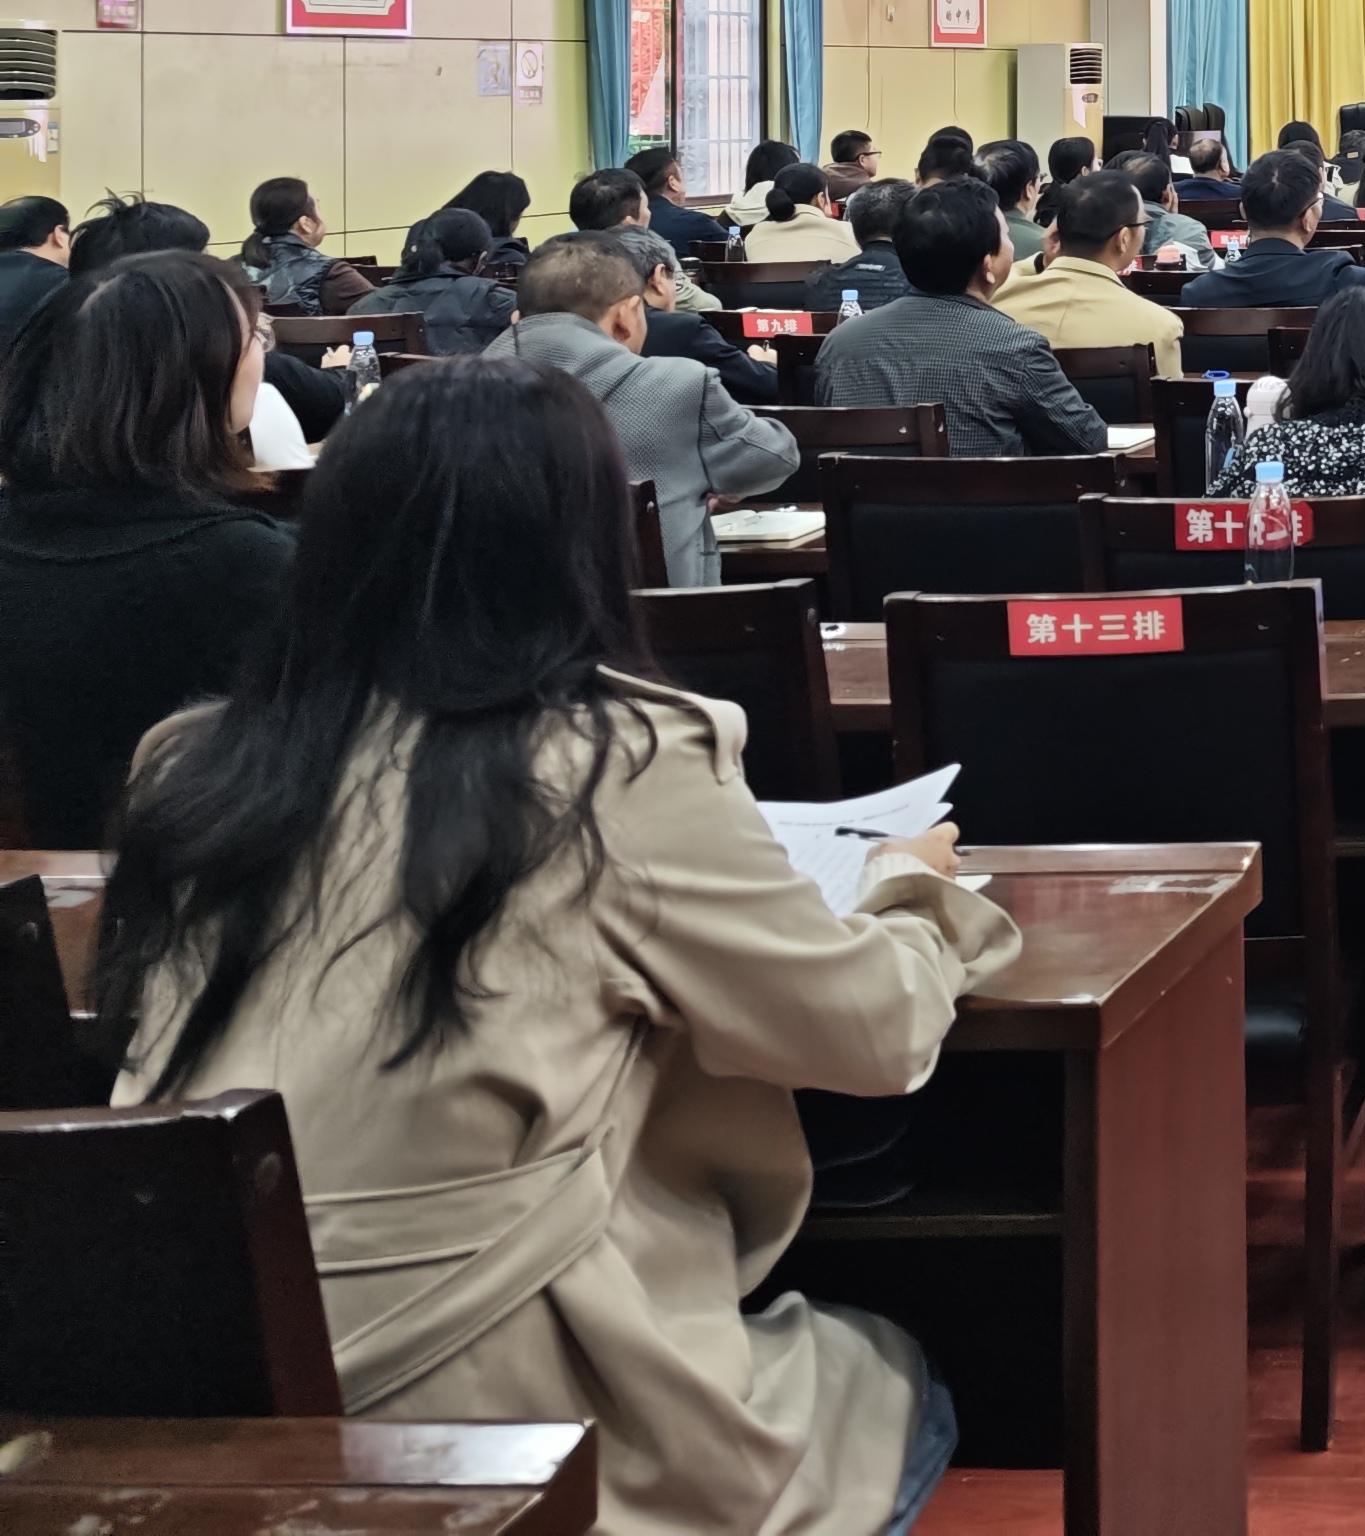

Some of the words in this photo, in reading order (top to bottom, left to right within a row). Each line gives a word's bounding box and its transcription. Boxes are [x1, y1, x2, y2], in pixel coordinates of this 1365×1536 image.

[756, 318, 798, 333] 第九排
[1026, 610, 1166, 644] 第十三排
